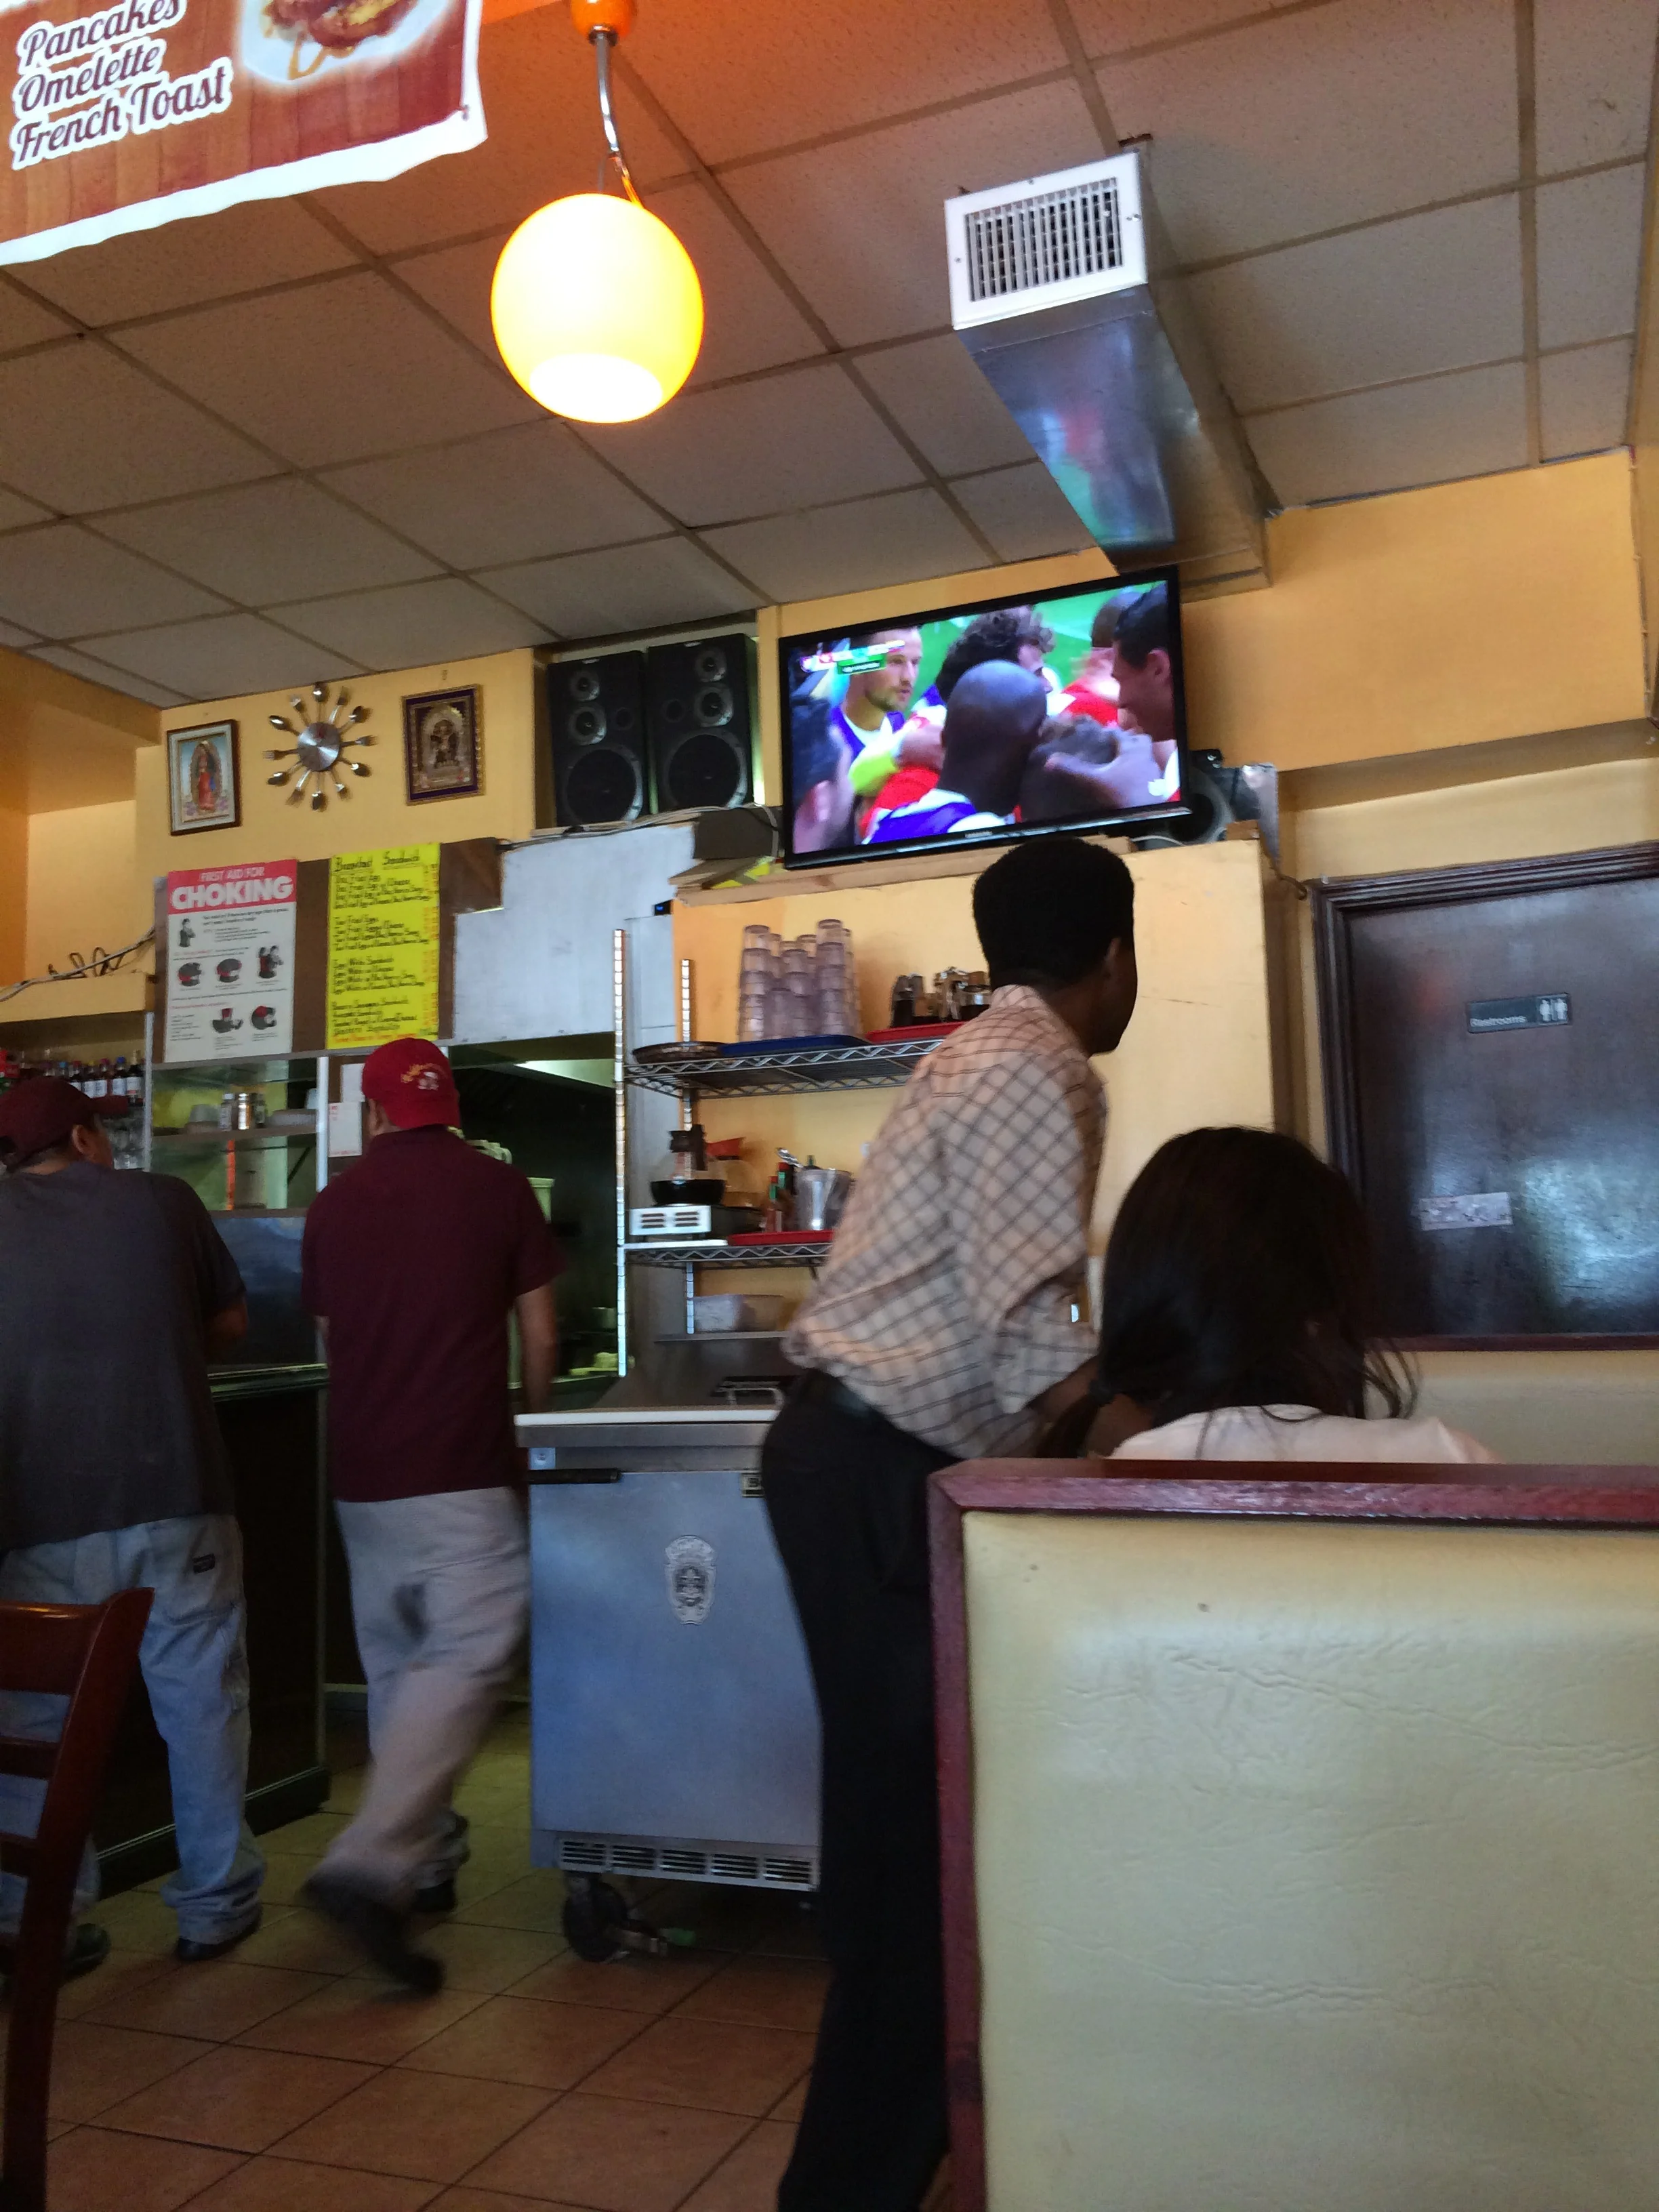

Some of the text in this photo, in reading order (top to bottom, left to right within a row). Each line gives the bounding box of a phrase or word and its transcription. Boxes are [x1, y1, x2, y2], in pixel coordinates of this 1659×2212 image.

[23, 0, 180, 66] Pancakes
[19, 44, 160, 111] Omelette
[17, 66, 226, 162] French Toast
[171, 875, 293, 909] CHOKING
